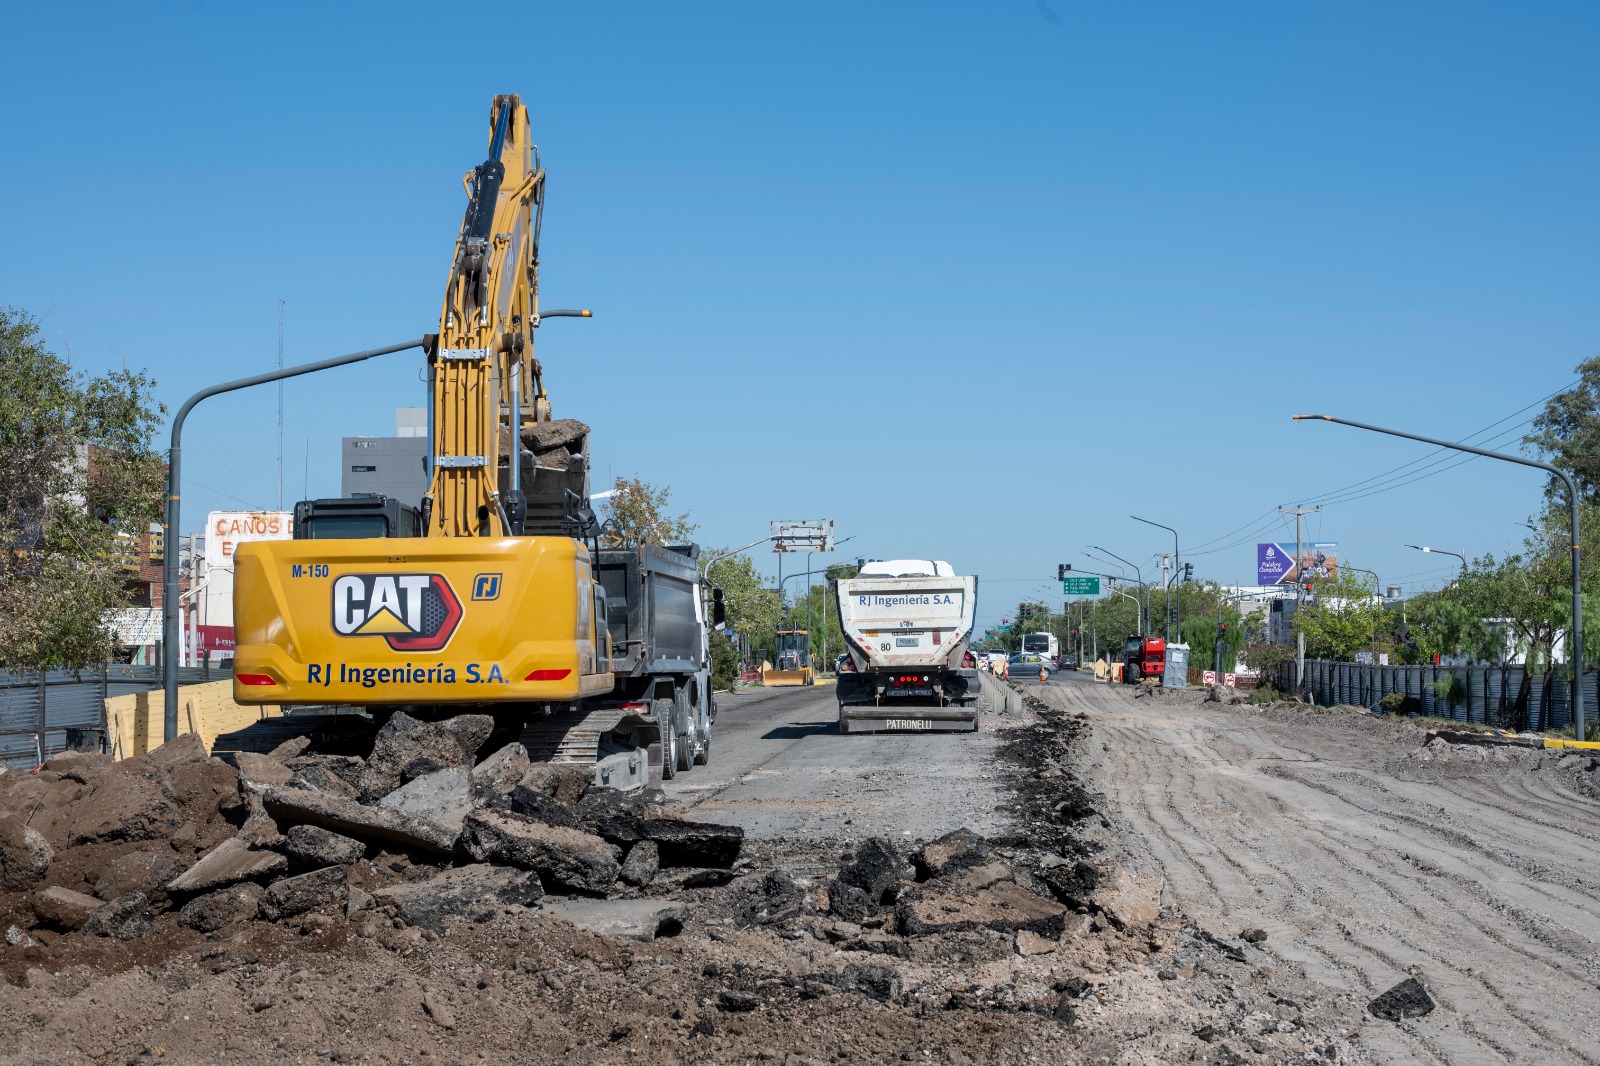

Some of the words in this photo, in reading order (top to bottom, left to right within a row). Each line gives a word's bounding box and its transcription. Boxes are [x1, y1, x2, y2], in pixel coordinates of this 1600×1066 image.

[291, 564, 329, 578] M-150
[334, 575, 430, 634] CAT
[859, 595, 871, 607] RJ
[875, 594, 930, 608] Ingeniería
[933, 594, 954, 605] S.A.
[880, 642, 891, 652] 80
[307, 663, 332, 687] RJ
[340, 662, 457, 688] Ingeniería
[465, 663, 510, 684] S.A.
[886, 719, 932, 730] PATRONELLI
